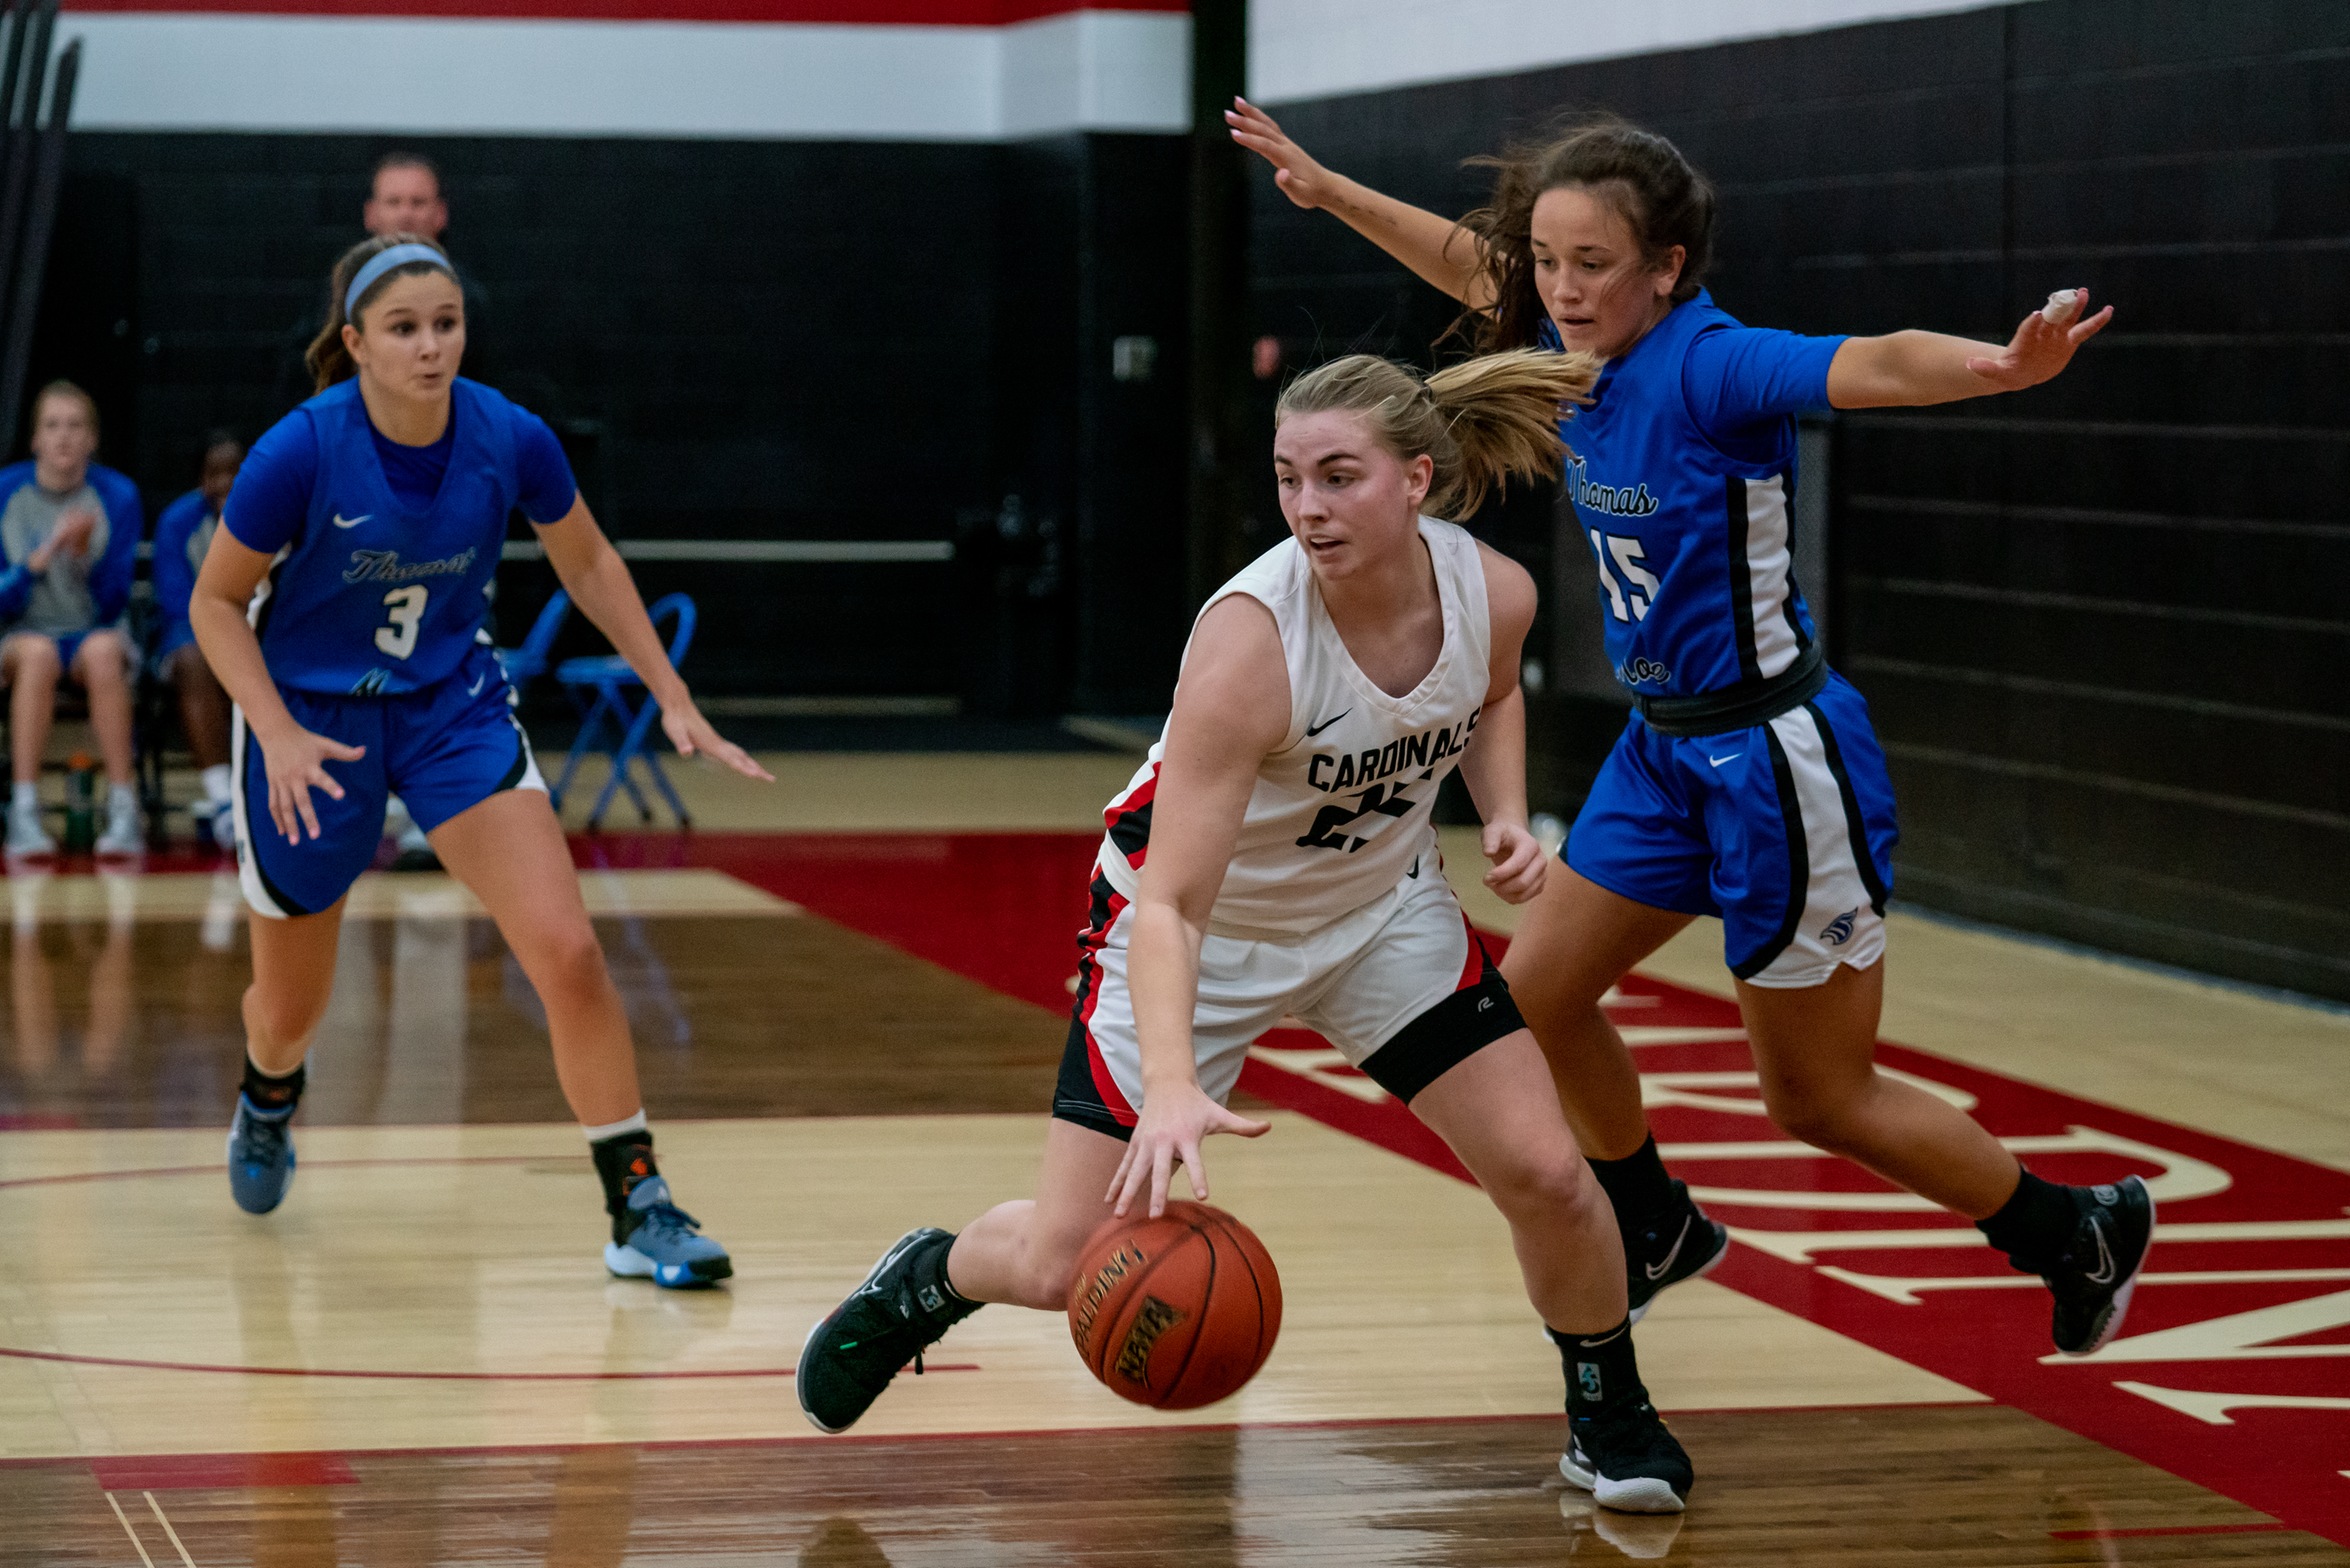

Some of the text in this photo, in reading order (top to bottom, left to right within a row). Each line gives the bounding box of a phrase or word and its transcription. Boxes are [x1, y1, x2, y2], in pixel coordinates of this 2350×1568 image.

[1567, 456, 1659, 517] Thomas
[1590, 528, 1661, 623] 15
[374, 584, 429, 661] 3
[1307, 706, 1481, 793] CARDINALS
